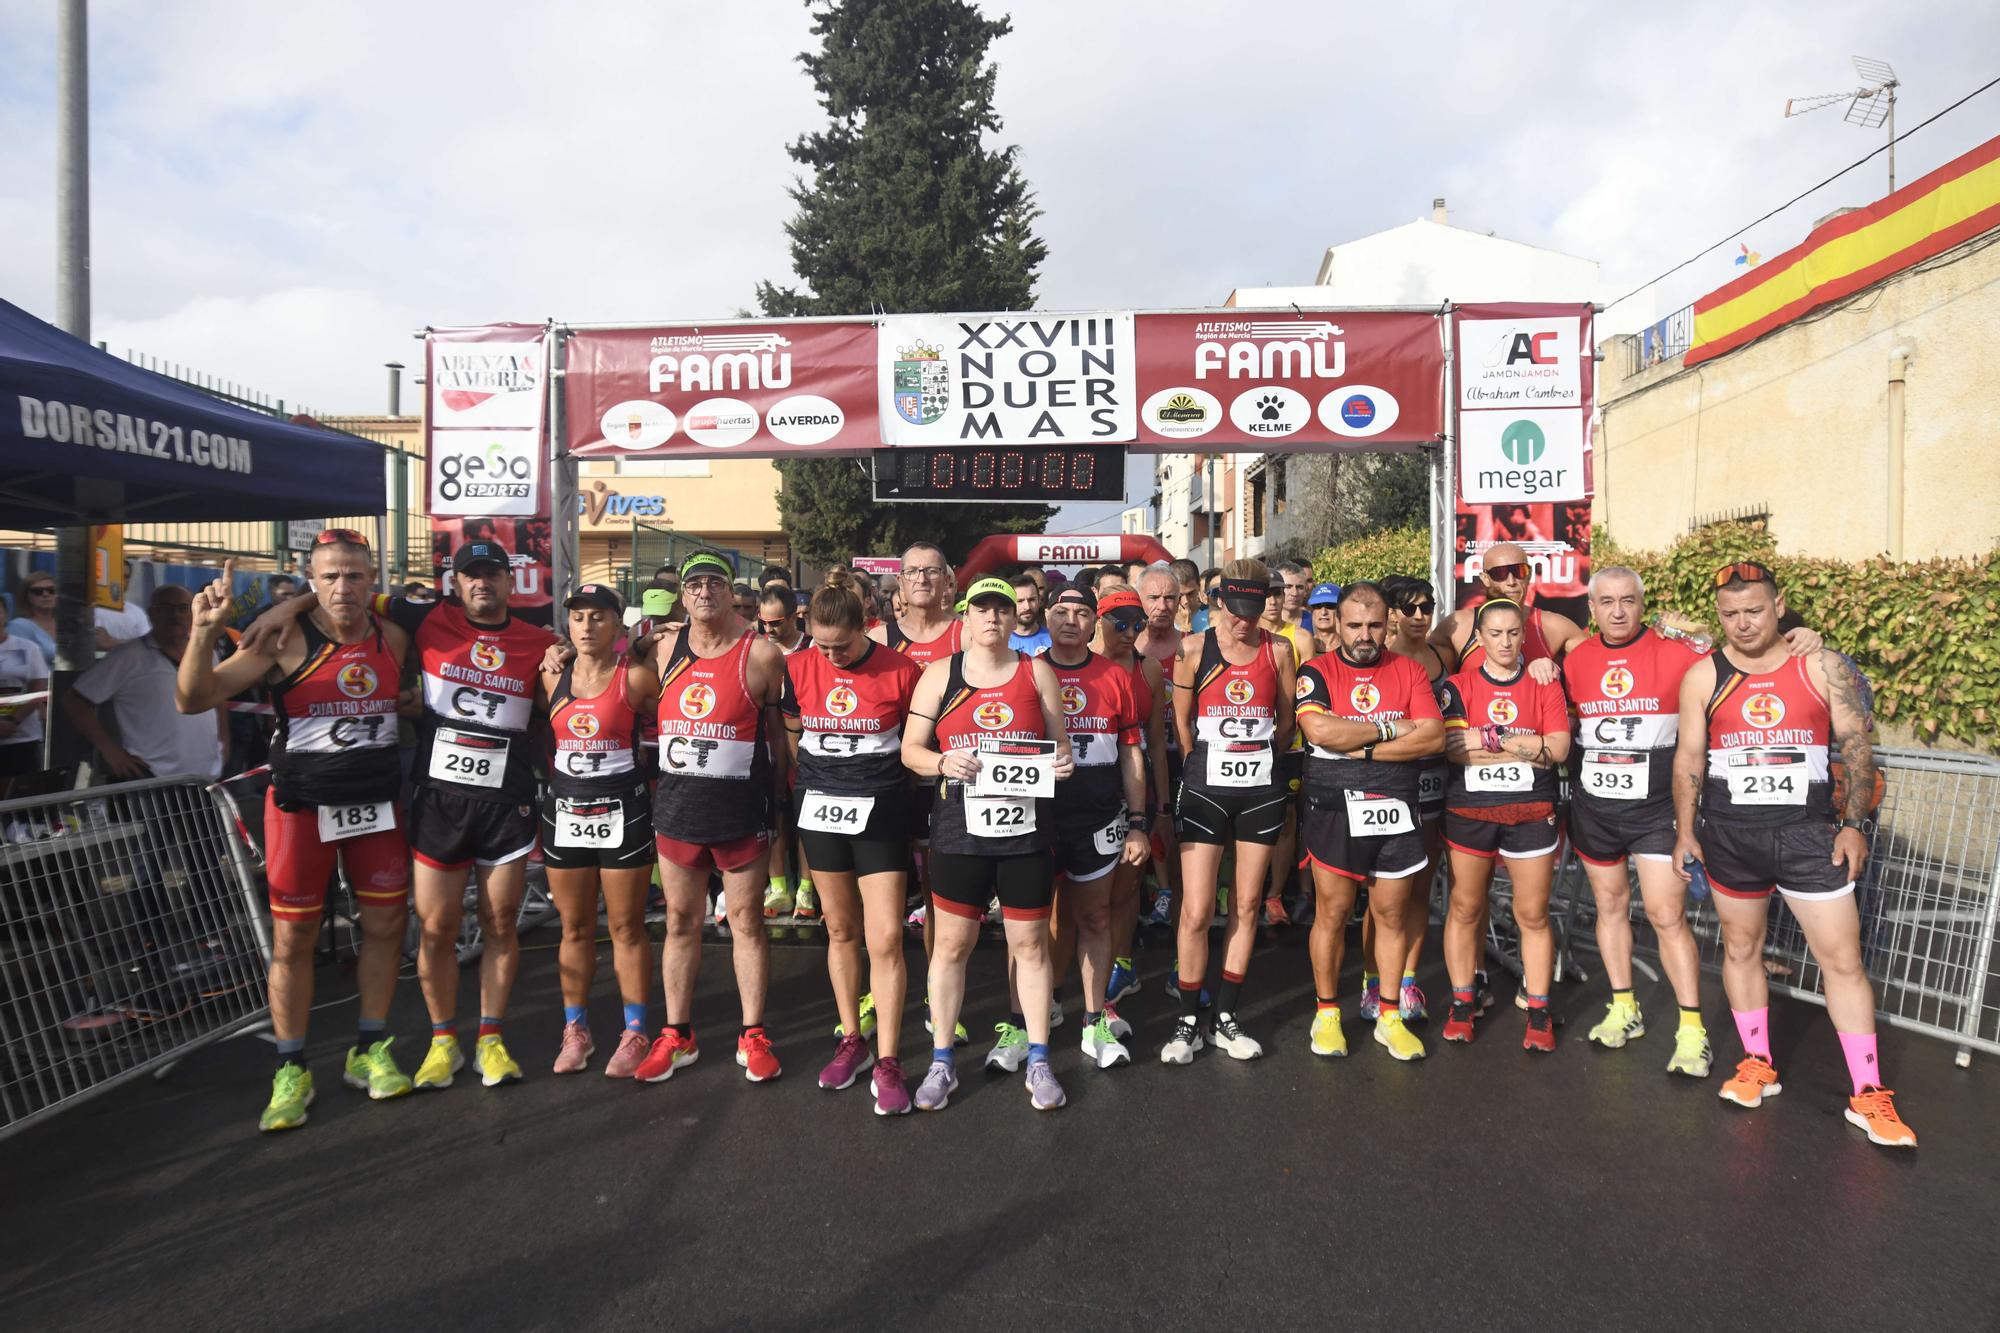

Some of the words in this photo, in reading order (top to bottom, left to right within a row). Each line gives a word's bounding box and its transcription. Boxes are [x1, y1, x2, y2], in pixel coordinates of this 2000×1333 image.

[957, 318, 1114, 350] XXVIII
[1195, 321, 1251, 332] ATLETISMO
[650, 335, 703, 347] ATLETISMO
[1195, 341, 1346, 380] FAMU
[649, 352, 792, 393] FAMU
[962, 378, 1120, 409] DUER
[1466, 386, 1520, 401] Abraham
[1525, 383, 1575, 399] Cambres
[771, 416, 787, 426] LA
[787, 415, 839, 426] VERDAD
[1249, 423, 1292, 432] KELME
[18, 395, 253, 475] DORSAL21.COM
[466, 484, 529, 498] SPORTS
[1479, 468, 1567, 495] megar
[1038, 544, 1100, 560] FAMU
[980, 581, 1006, 591] ANIMAL
[439, 661, 482, 684] CUATRO
[484, 673, 525, 694] SANTOS
[451, 686, 508, 719] CT
[1206, 705, 1238, 716] CUATRO
[1579, 700, 1617, 715] CUATRO
[1618, 698, 1660, 712] SANTOS
[329, 714, 385, 747] CT
[692, 722, 737, 740] SANTOS
[801, 715, 838, 730] CUATRO
[840, 718, 881, 731] SANTOS
[1072, 716, 1109, 730] SANTOS
[1219, 716, 1260, 738] CT
[1594, 716, 1643, 744] CT
[585, 738, 620, 751] SANTOS
[818, 732, 866, 754] CT
[1720, 730, 1764, 748] CUATRO
[1767, 728, 1814, 745] SANTOS
[666, 735, 719, 769] CT
[444, 753, 491, 776] 298
[566, 751, 608, 776] CT
[1220, 761, 1262, 777] 507
[992, 765, 1040, 785] 629
[1478, 766, 1521, 781] 643
[1592, 772, 1634, 790] 393
[1743, 775, 1794, 794] 284
[331, 804, 379, 828] 183
[813, 804, 859, 825] 494
[980, 806, 1025, 826] 122
[1362, 808, 1400, 826] 200
[569, 823, 611, 839] 346
[1105, 825, 1123, 844] 56
